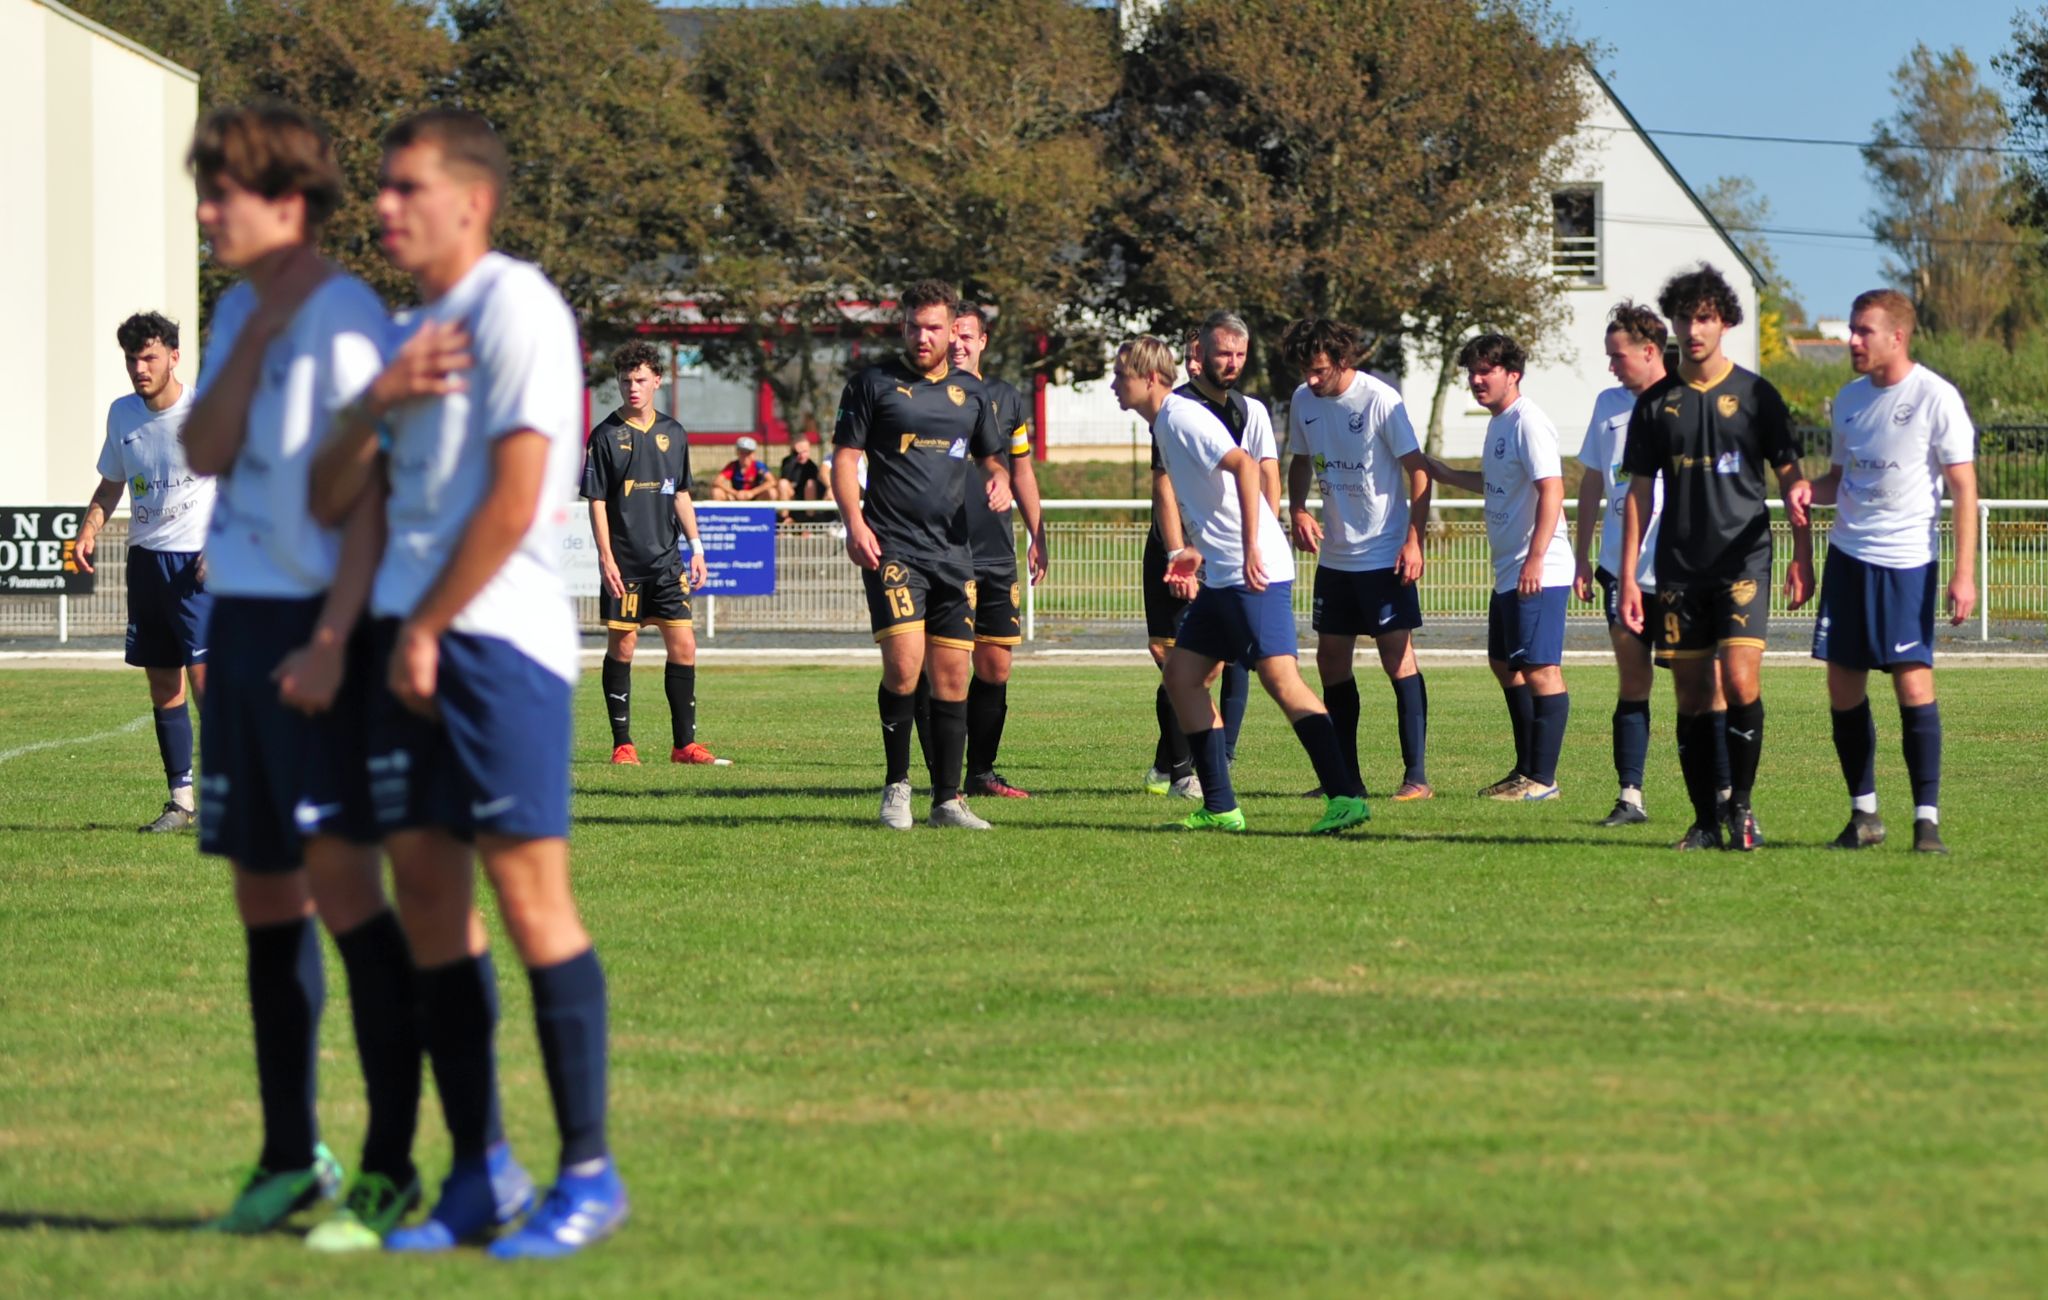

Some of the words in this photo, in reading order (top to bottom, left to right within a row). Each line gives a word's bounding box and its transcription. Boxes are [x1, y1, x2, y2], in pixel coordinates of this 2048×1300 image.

[0, 512, 78, 540] NG
[620, 591, 639, 618] 14
[884, 586, 915, 619] 13
[1664, 612, 1681, 645] 9
